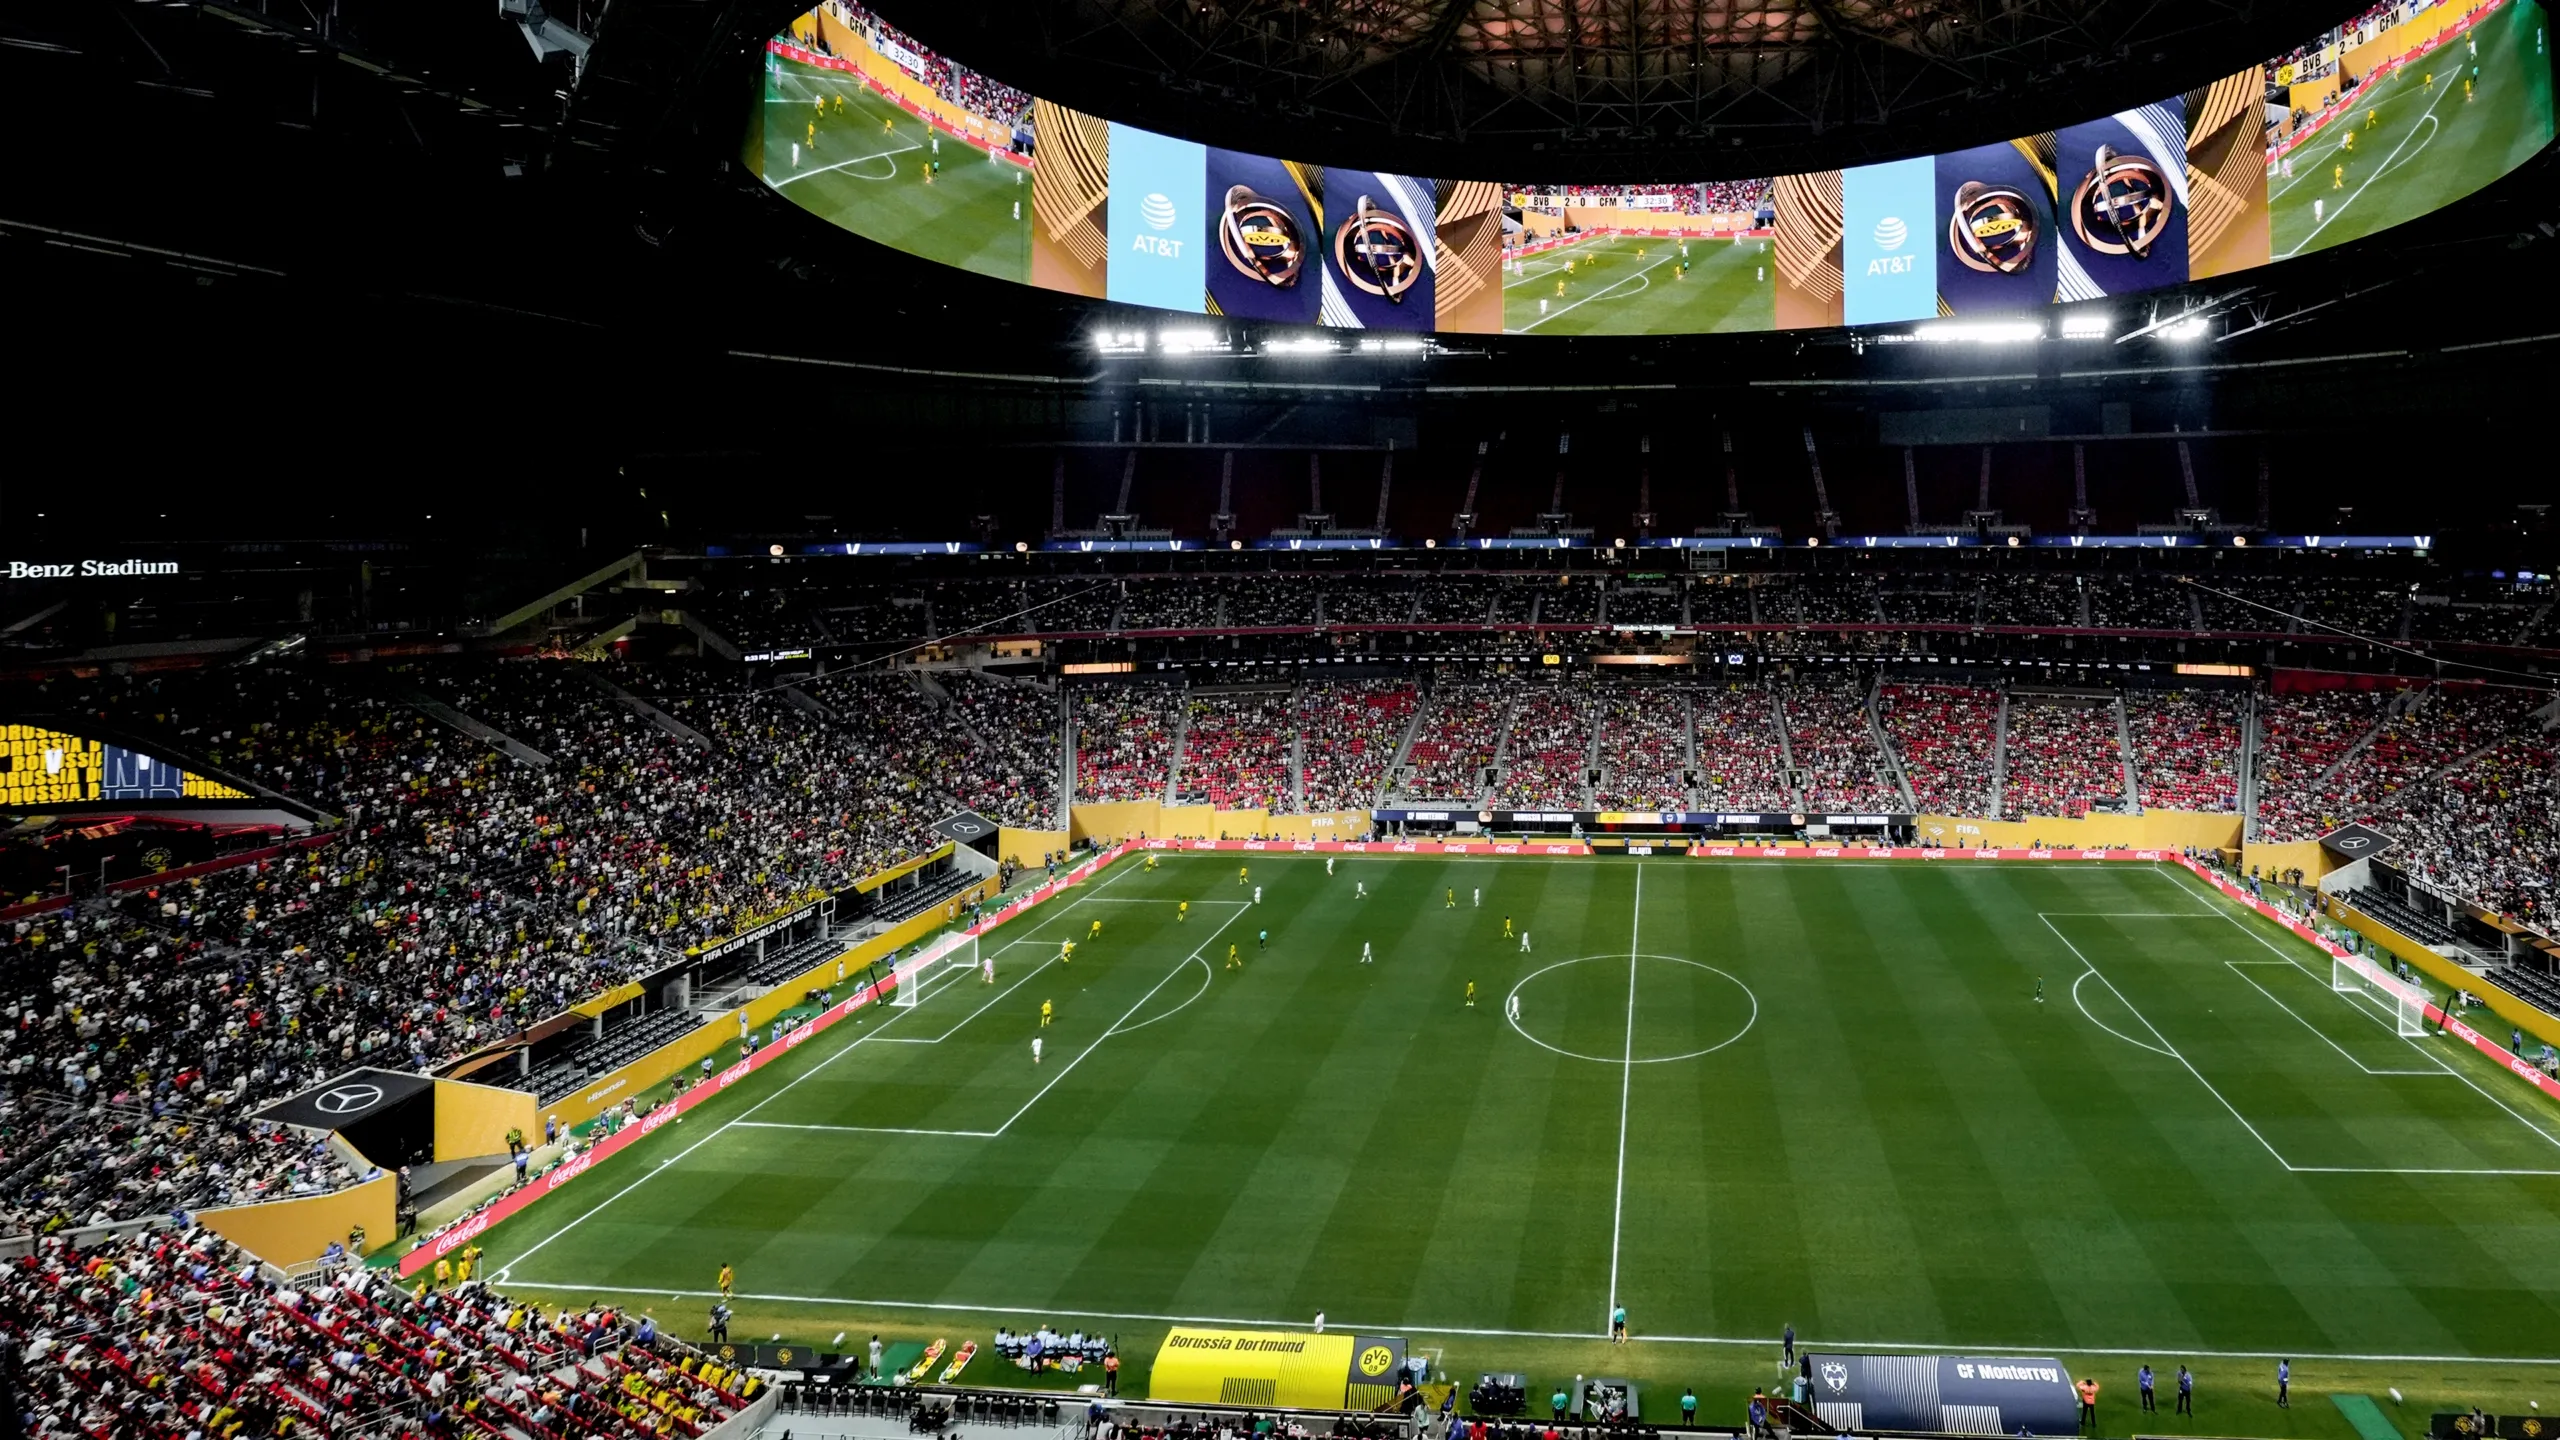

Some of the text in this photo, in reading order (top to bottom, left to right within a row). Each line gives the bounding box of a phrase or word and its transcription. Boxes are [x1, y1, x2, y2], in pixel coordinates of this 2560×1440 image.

[2380, 9, 2399, 32] CFM
[850, 16, 867, 40] CFM
[2339, 33, 2364, 55] 2 0
[894, 47, 919, 70] 32:30
[2302, 56, 2321, 73] BVB
[965, 115, 984, 129] FIFA
[1533, 196, 1617, 207] BVB 2 0 CFM
[1644, 197, 1668, 205] 32:30
[1133, 234, 1184, 258] AT&T
[1867, 255, 1915, 277] AT&T
[80, 558, 179, 577] Stadium
[1311, 817, 1335, 827] FIFA
[1956, 824, 1980, 835] FIFA
[1145, 839, 1167, 848] Coca-Cola
[1194, 840, 1216, 850] Coca-Cola
[1244, 841, 1265, 850] Coca-Cola
[1293, 842, 1316, 851] Coca-Cola
[1343, 842, 1366, 852] Coca-Cola
[1394, 843, 1416, 853] Coca-Cola
[1444, 843, 1467, 853] Coca-Cola
[1495, 844, 1518, 854] Coca-Cola
[1546, 845, 1569, 855] Coca-Cola
[1710, 847, 1734, 857] Coca-Cola
[1763, 847, 1786, 857] Coca-Cola
[1816, 848, 1839, 857] Coca-Cola
[1869, 848, 1892, 858] Coca-Cola
[1921, 849, 1945, 858] Coca-Cola
[1975, 849, 1999, 858] Coca-Cola
[2028, 849, 2053, 859] Coca-Cola
[2082, 850, 2106, 860] Coca-Cola
[2135, 851, 2160, 860] Coca-Cola
[702, 950, 723, 964] FIFA
[723, 938, 746, 955] CLUB
[746, 924, 776, 947] WORLD
[776, 917, 793, 930] CUP
[844, 990, 868, 1014] Coca-Cola
[786, 1021, 815, 1048] Coca-Cola
[2451, 1020, 2478, 1046] Coca-Cola
[719, 1058, 751, 1087] Coca-Cola
[2511, 1059, 2541, 1086] Coca-Cola
[587, 1078, 627, 1104] Hisense
[640, 1100, 679, 1134] Coca-Cola
[548, 1150, 595, 1190] Coca-Cola
[435, 1209, 490, 1256] Coca-Cola
[1169, 1335, 1305, 1354] Borussia Dortmund
[1363, 1349, 1388, 1367] BVB
[1368, 1364, 1378, 1373] 09
[1957, 1363, 2059, 1384] CF Monterrey
